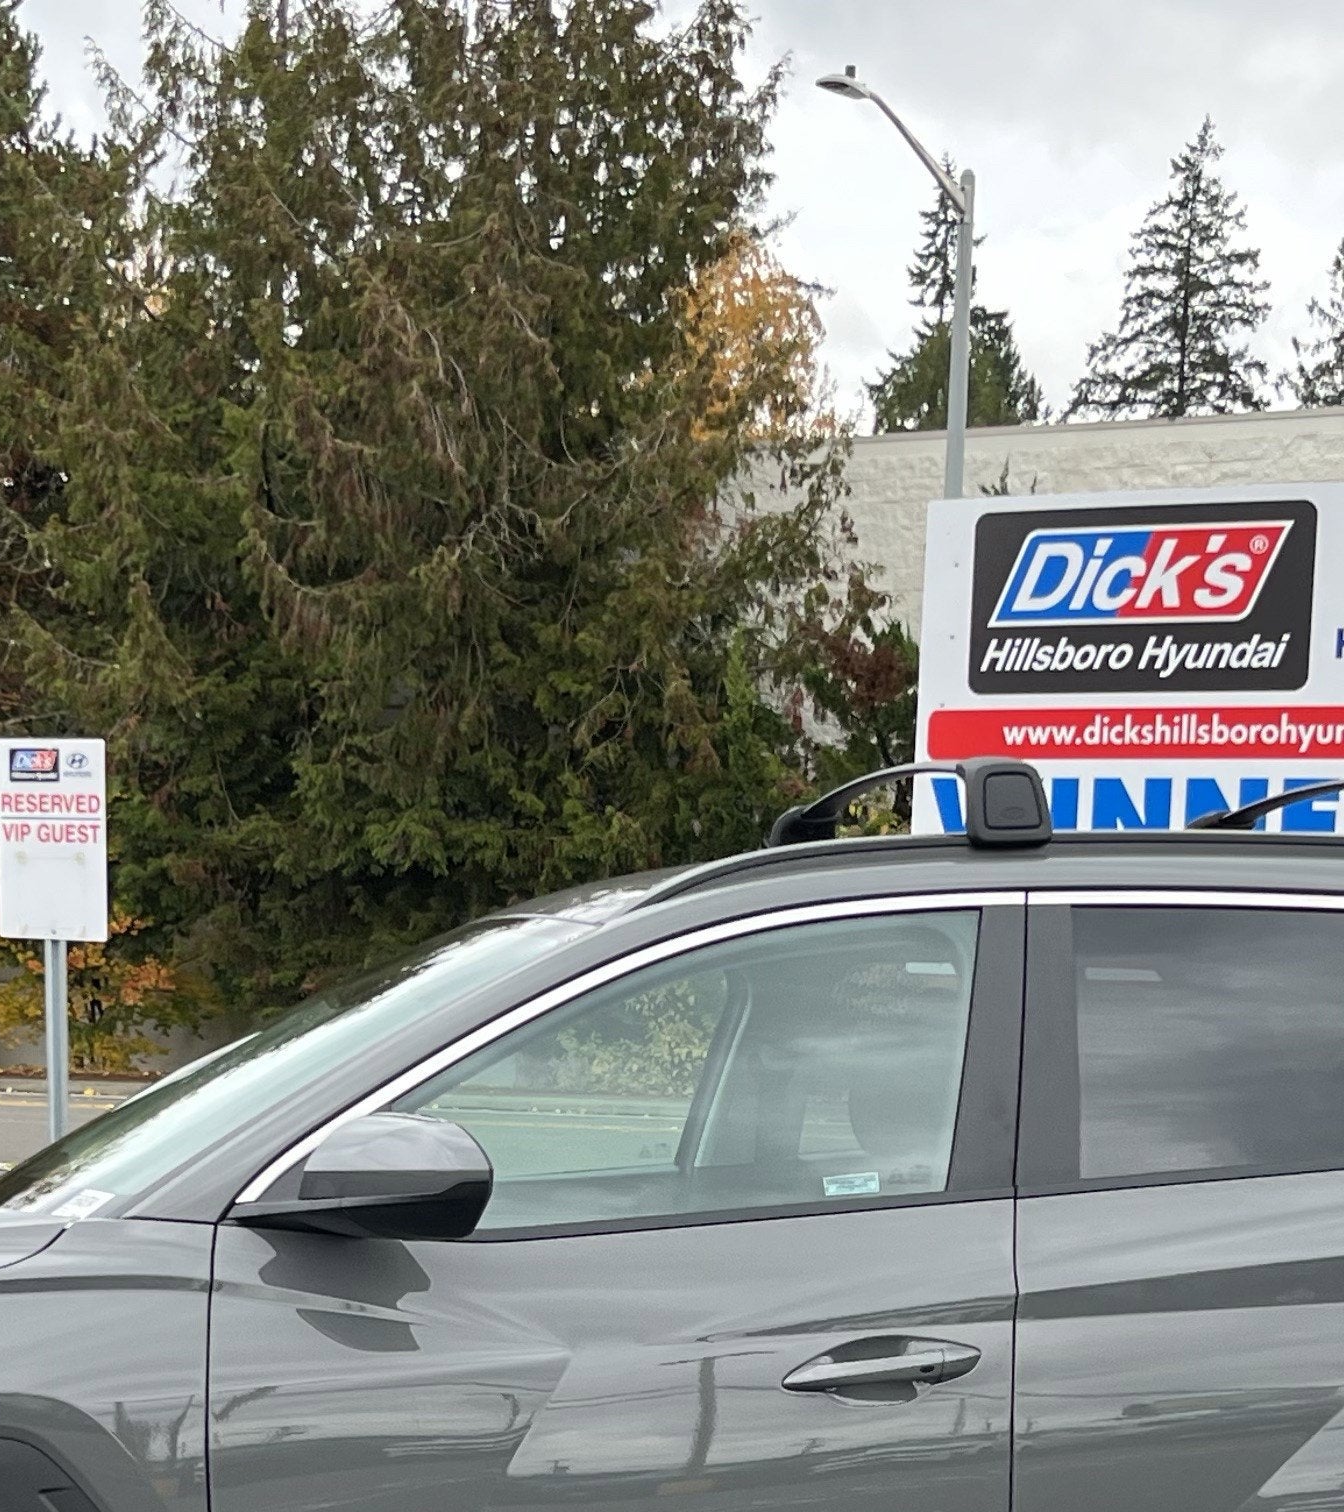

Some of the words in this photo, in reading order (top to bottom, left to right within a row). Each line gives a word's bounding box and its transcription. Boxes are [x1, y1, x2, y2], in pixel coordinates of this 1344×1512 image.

[1011, 534, 1254, 613] Dick's
[980, 636, 1134, 673] Hillsboro
[1137, 631, 1292, 679] Hyundai
[1, 793, 101, 814] RESERVED
[2, 823, 31, 843] VIP
[37, 823, 101, 844] GUEST
